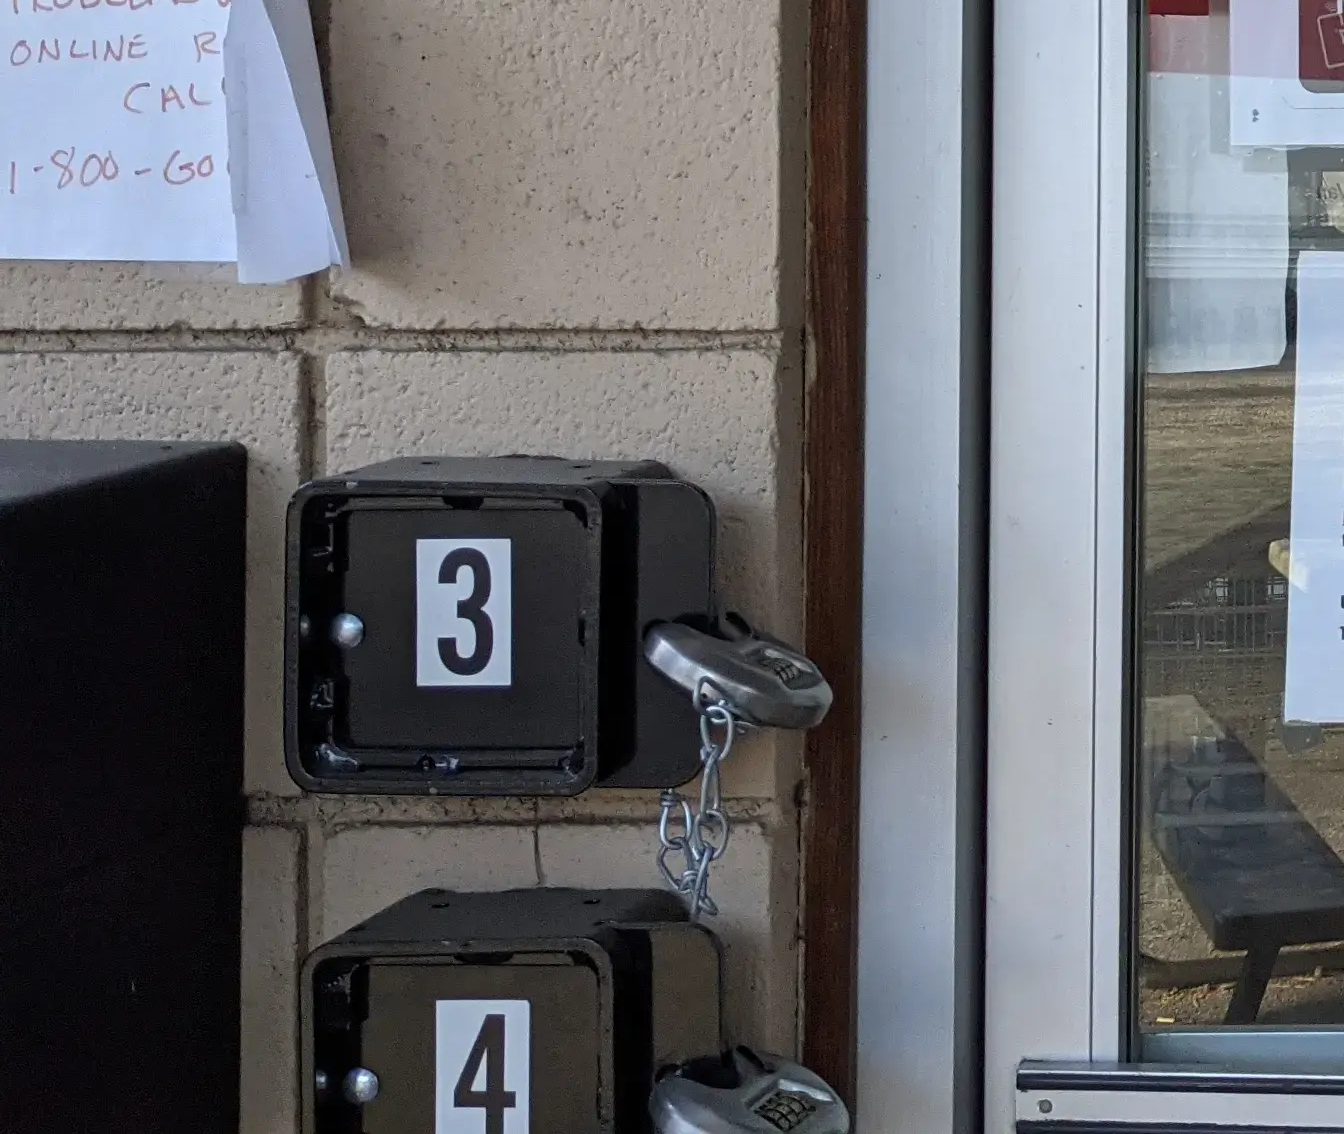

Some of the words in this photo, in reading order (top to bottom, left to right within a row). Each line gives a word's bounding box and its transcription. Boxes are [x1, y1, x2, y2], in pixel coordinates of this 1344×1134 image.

[9, 33, 149, 66] ONLINE
[123, 79, 222, 114] CAL
[437, 547, 494, 677] 3
[453, 1013, 516, 1134] 4
